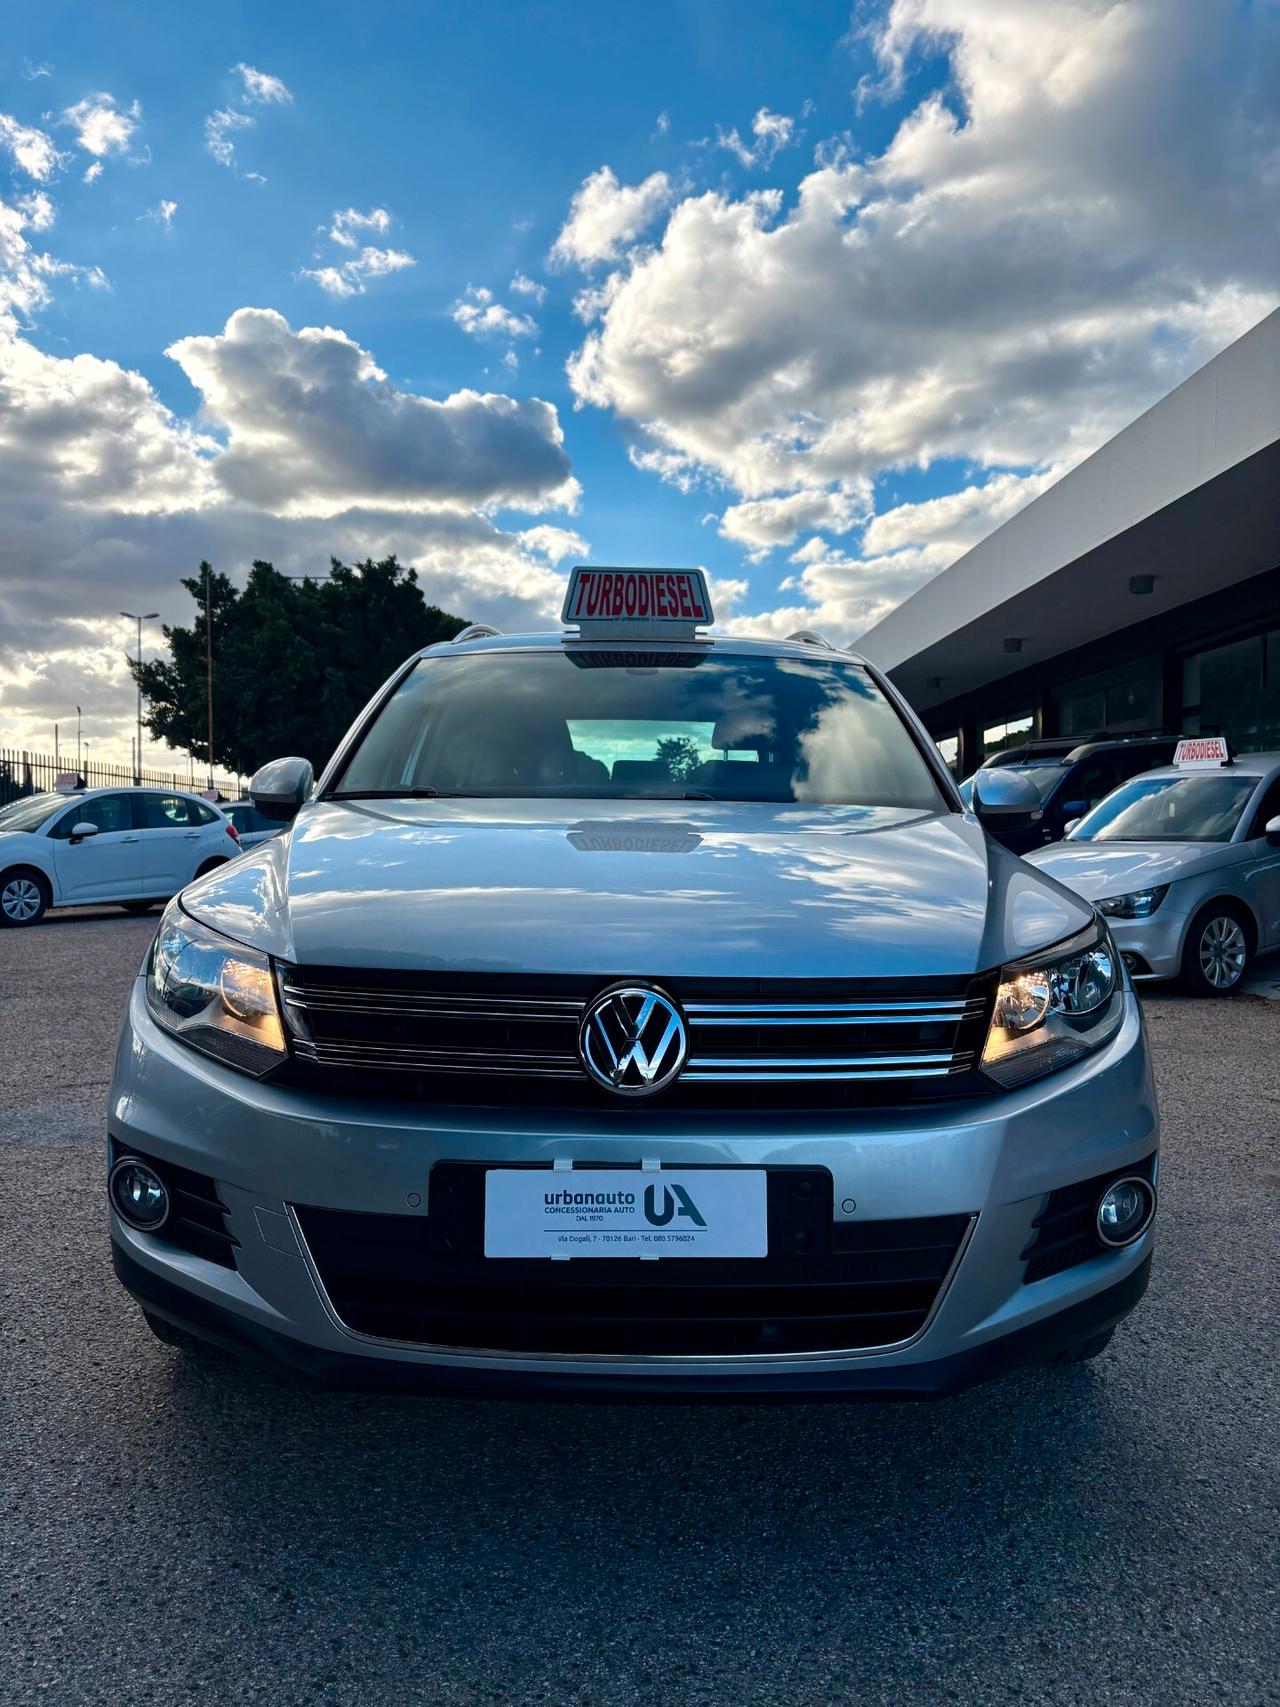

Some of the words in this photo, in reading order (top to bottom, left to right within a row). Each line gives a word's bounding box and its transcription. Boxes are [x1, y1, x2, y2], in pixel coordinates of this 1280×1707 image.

[575, 573, 704, 618] TURBODIESEL
[1178, 740, 1224, 760] TURBODIESEL
[585, 989, 685, 1088] VW
[544, 1189, 635, 1205] urbanauto
[544, 1206, 612, 1214] CONCESSIONARIA
[613, 1206, 635, 1214] AUTO
[644, 1184, 708, 1226] UA
